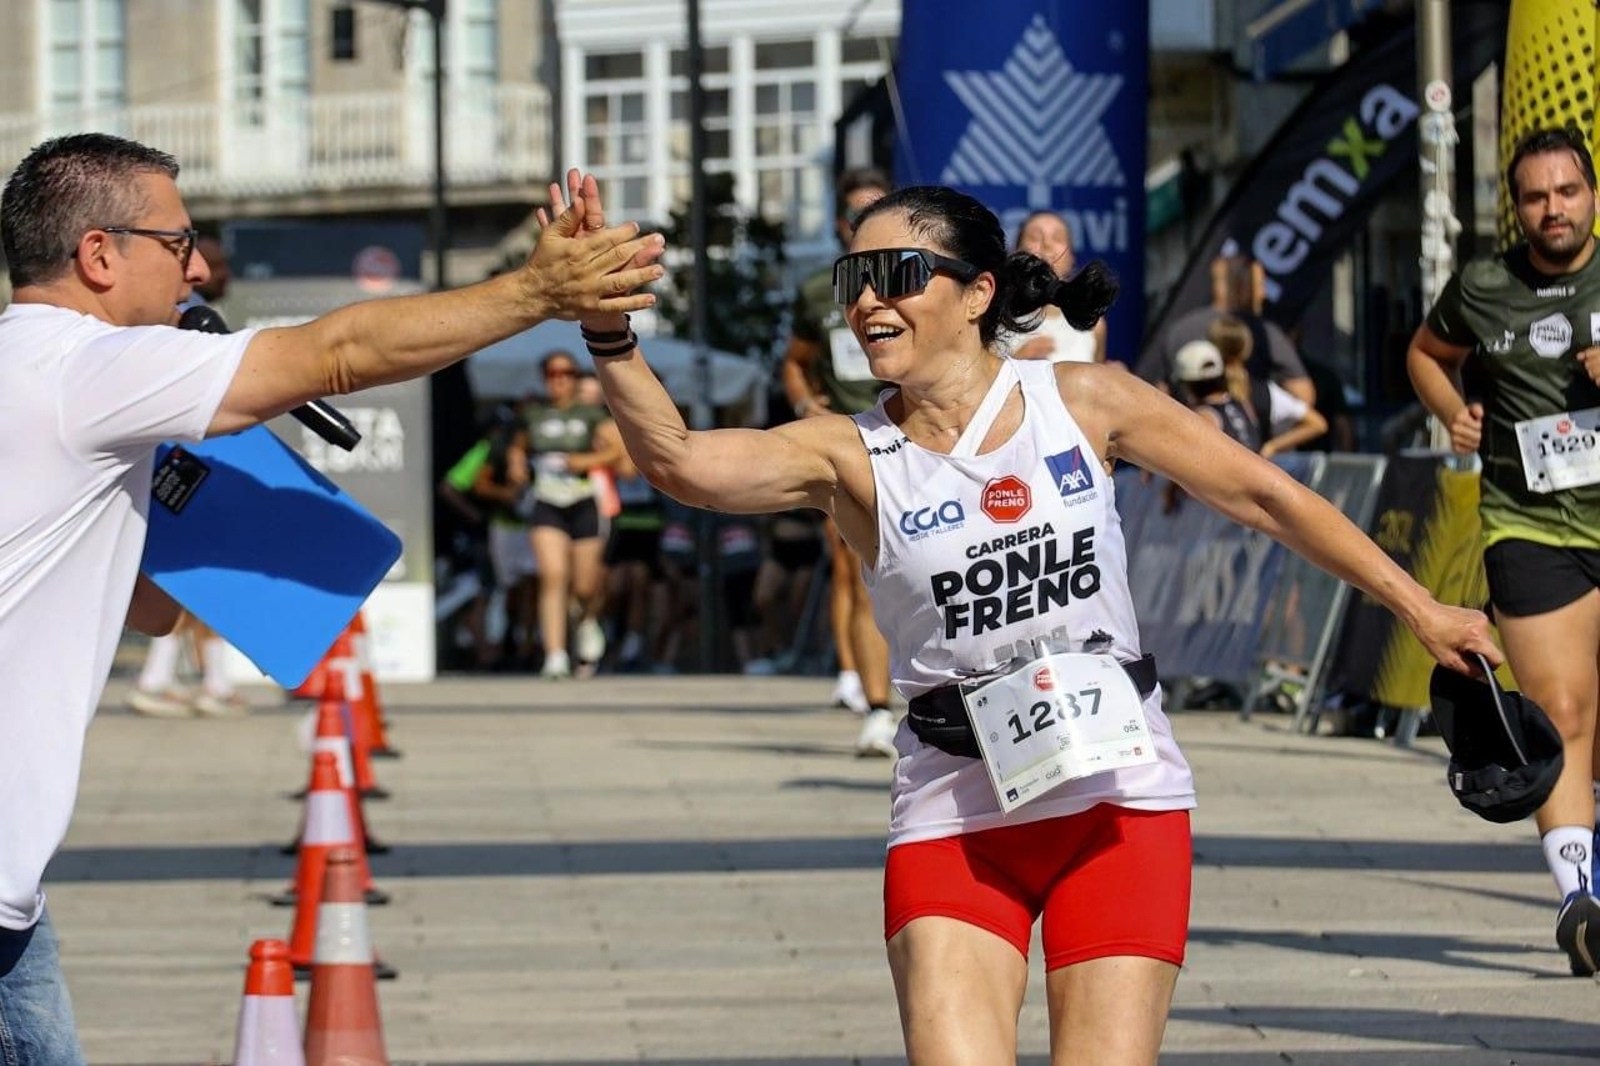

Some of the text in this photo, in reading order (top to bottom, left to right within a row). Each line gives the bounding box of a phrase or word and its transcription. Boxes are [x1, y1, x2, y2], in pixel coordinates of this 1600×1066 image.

[988, 488, 1025, 499] PONLE
[1060, 469, 1089, 493] AXA
[987, 497, 1025, 508] FRENO
[965, 522, 1055, 559] CARRERA
[931, 526, 1096, 607] PONLE
[945, 563, 1101, 640] FRENO
[1007, 686, 1102, 745] 1287
